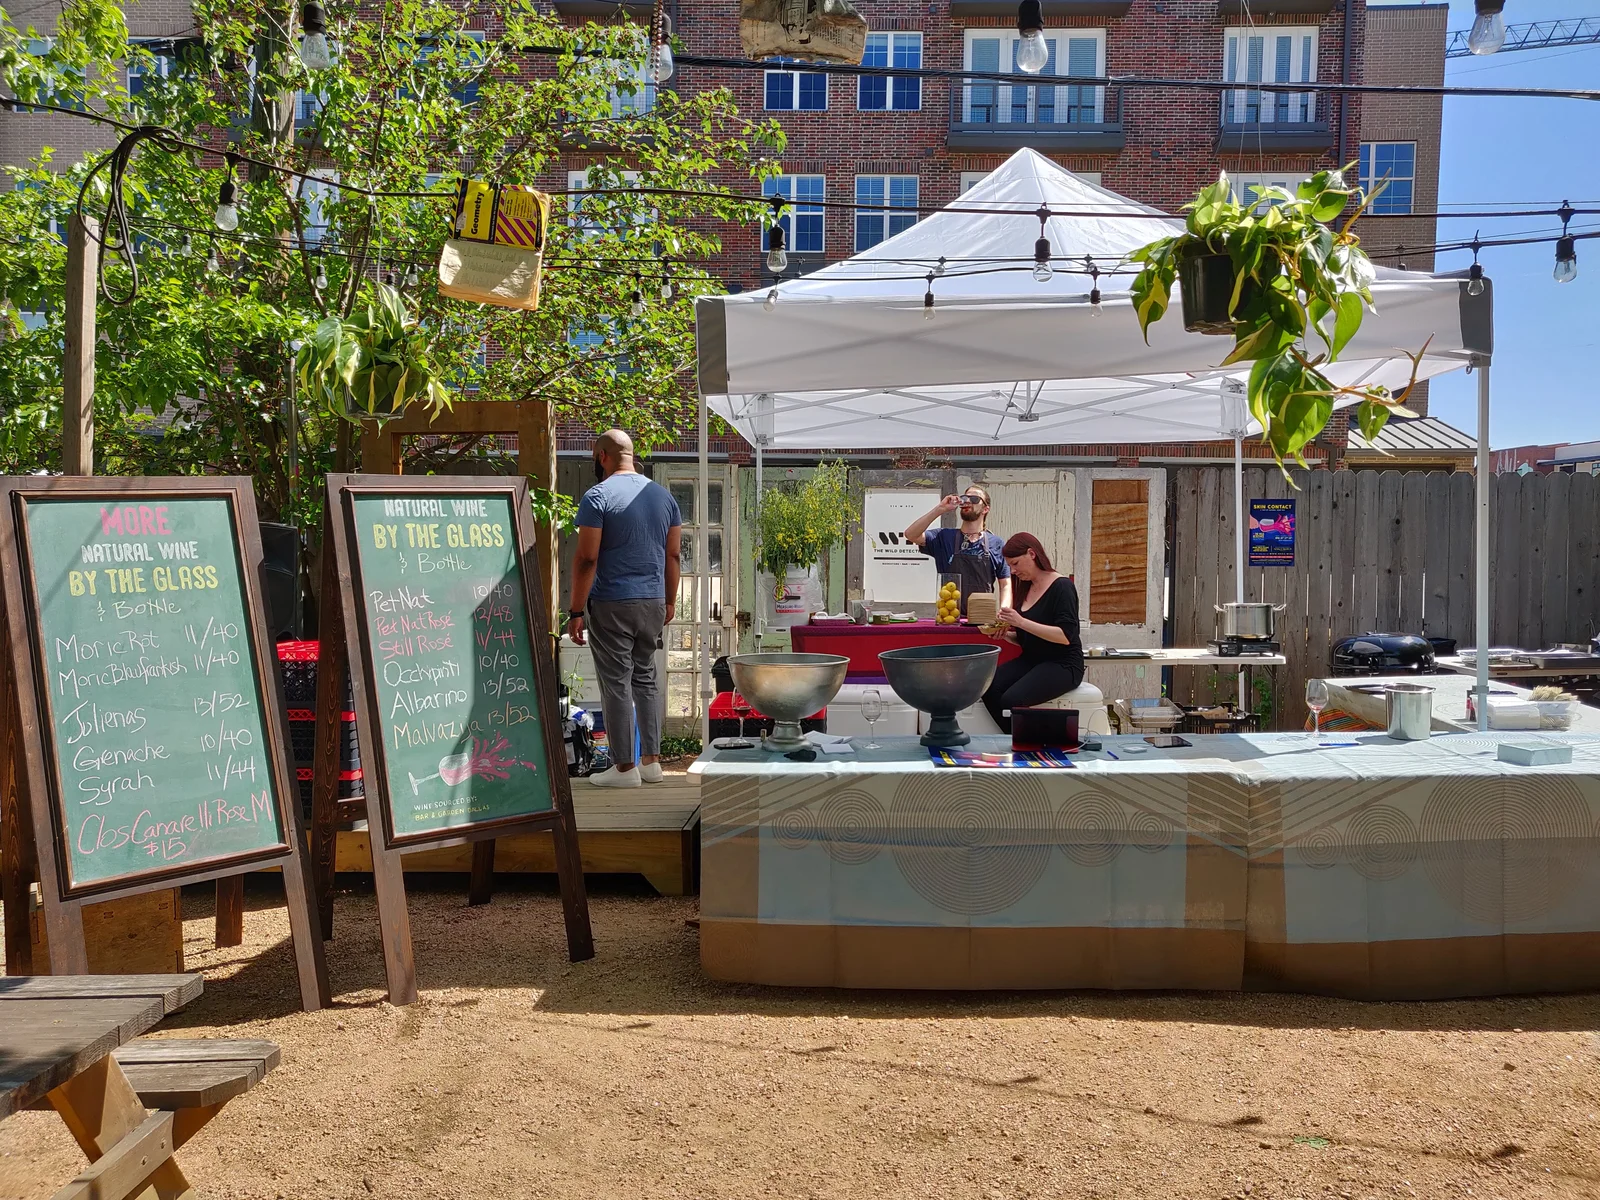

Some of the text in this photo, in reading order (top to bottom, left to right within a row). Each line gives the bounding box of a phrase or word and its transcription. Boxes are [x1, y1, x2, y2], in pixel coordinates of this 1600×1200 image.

[471, 192, 484, 235] Geometry
[100, 505, 171, 536] MORE
[384, 499, 488, 517] NATURAL WINE
[82, 541, 199, 563] NATURAL WINE
[373, 523, 504, 549] BY THE GLASS
[69, 565, 218, 596] BY THE GLASS
[417, 552, 472, 574] Bottle
[112, 598, 181, 620] Bottle
[370, 577, 513, 613] Pet Nat 10/40
[374, 616, 398, 636] Pet
[400, 613, 427, 634] Nat
[473, 601, 513, 626] 12/48
[56, 616, 238, 663] Moric Rot 11/40
[379, 640, 413, 660] Still
[475, 625, 516, 651] 11/44
[58, 668, 111, 699] Moric
[194, 647, 240, 675] 11/40
[479, 649, 519, 672] 10/40
[390, 672, 529, 719] Albarino 13/52
[62, 690, 249, 743] Julienas 13/52
[393, 701, 536, 749] Malvazija 13/52
[73, 719, 252, 771] Grenache 10/40
[78, 755, 256, 805] Syrah 11/44
[414, 803, 432, 811] WINE
[434, 797, 465, 809] SOURCED
[415, 813, 429, 821] BAR
[437, 808, 465, 818] GARDEN
[77, 814, 130, 854] Clos
[143, 837, 187, 860] $15
